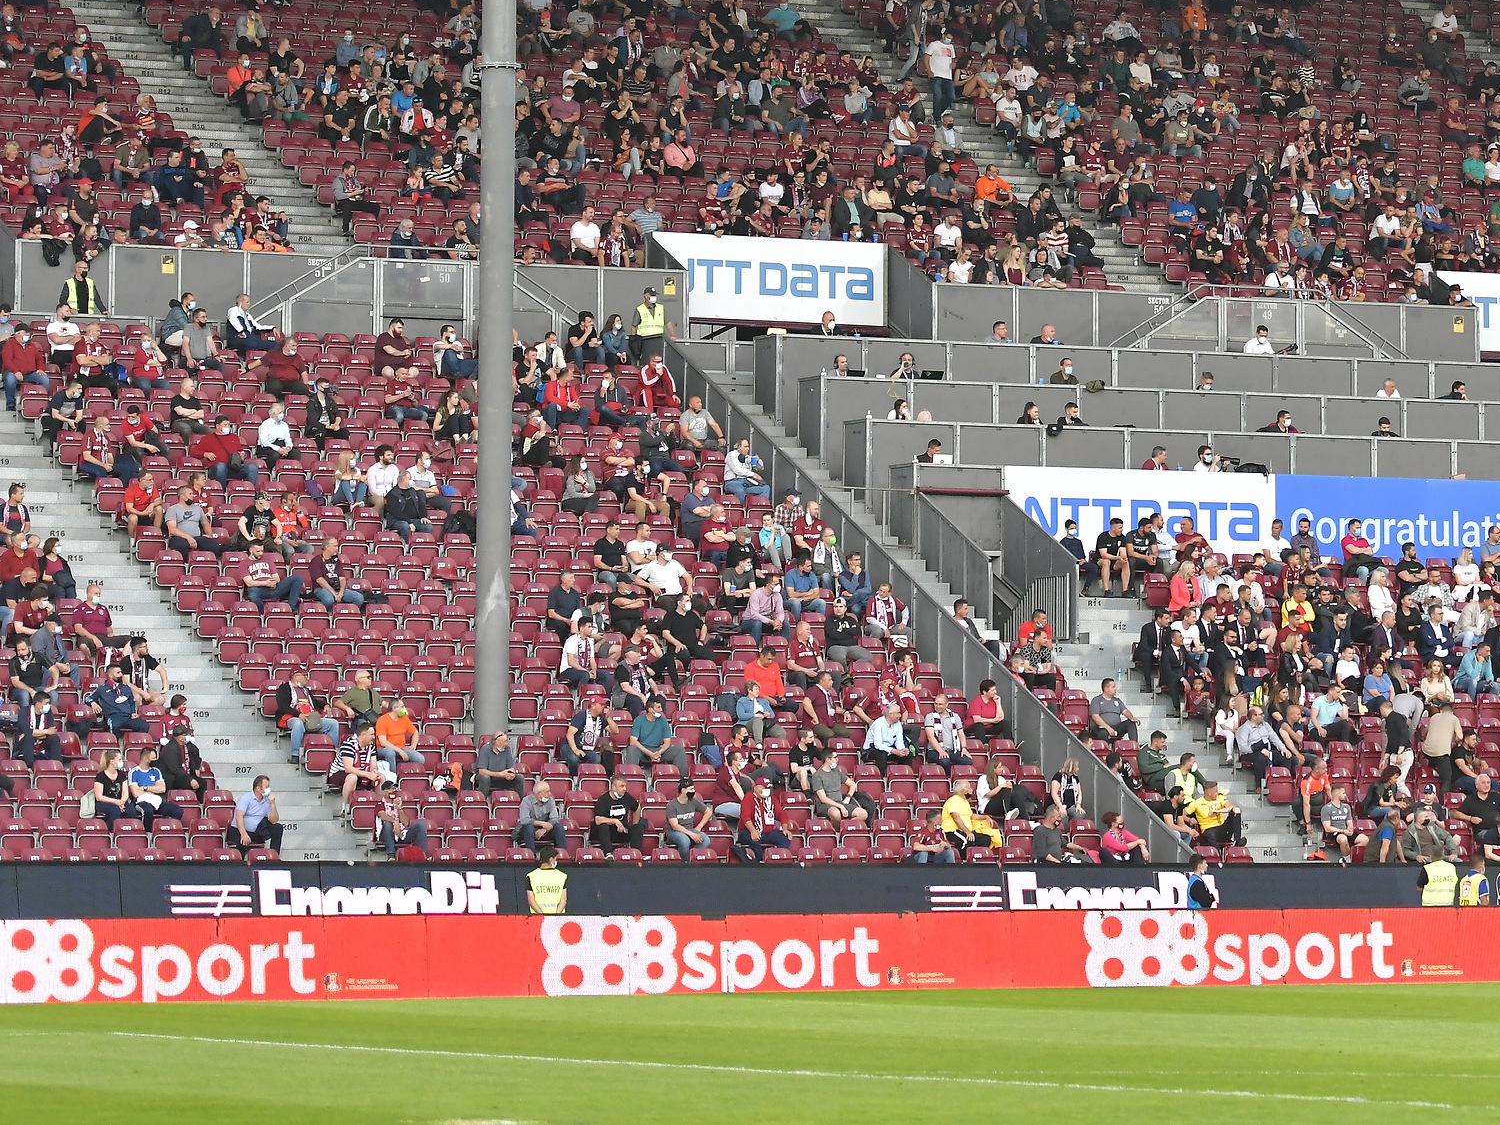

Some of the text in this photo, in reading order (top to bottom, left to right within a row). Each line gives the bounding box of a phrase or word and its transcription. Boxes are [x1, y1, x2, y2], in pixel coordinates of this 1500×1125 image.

[440, 273, 450, 283] 50
[1148, 297, 1170, 305] SECTOR
[1262, 310, 1272, 319] 49
[1084, 911, 1394, 987] 888sport
[540, 916, 880, 996] 888sport
